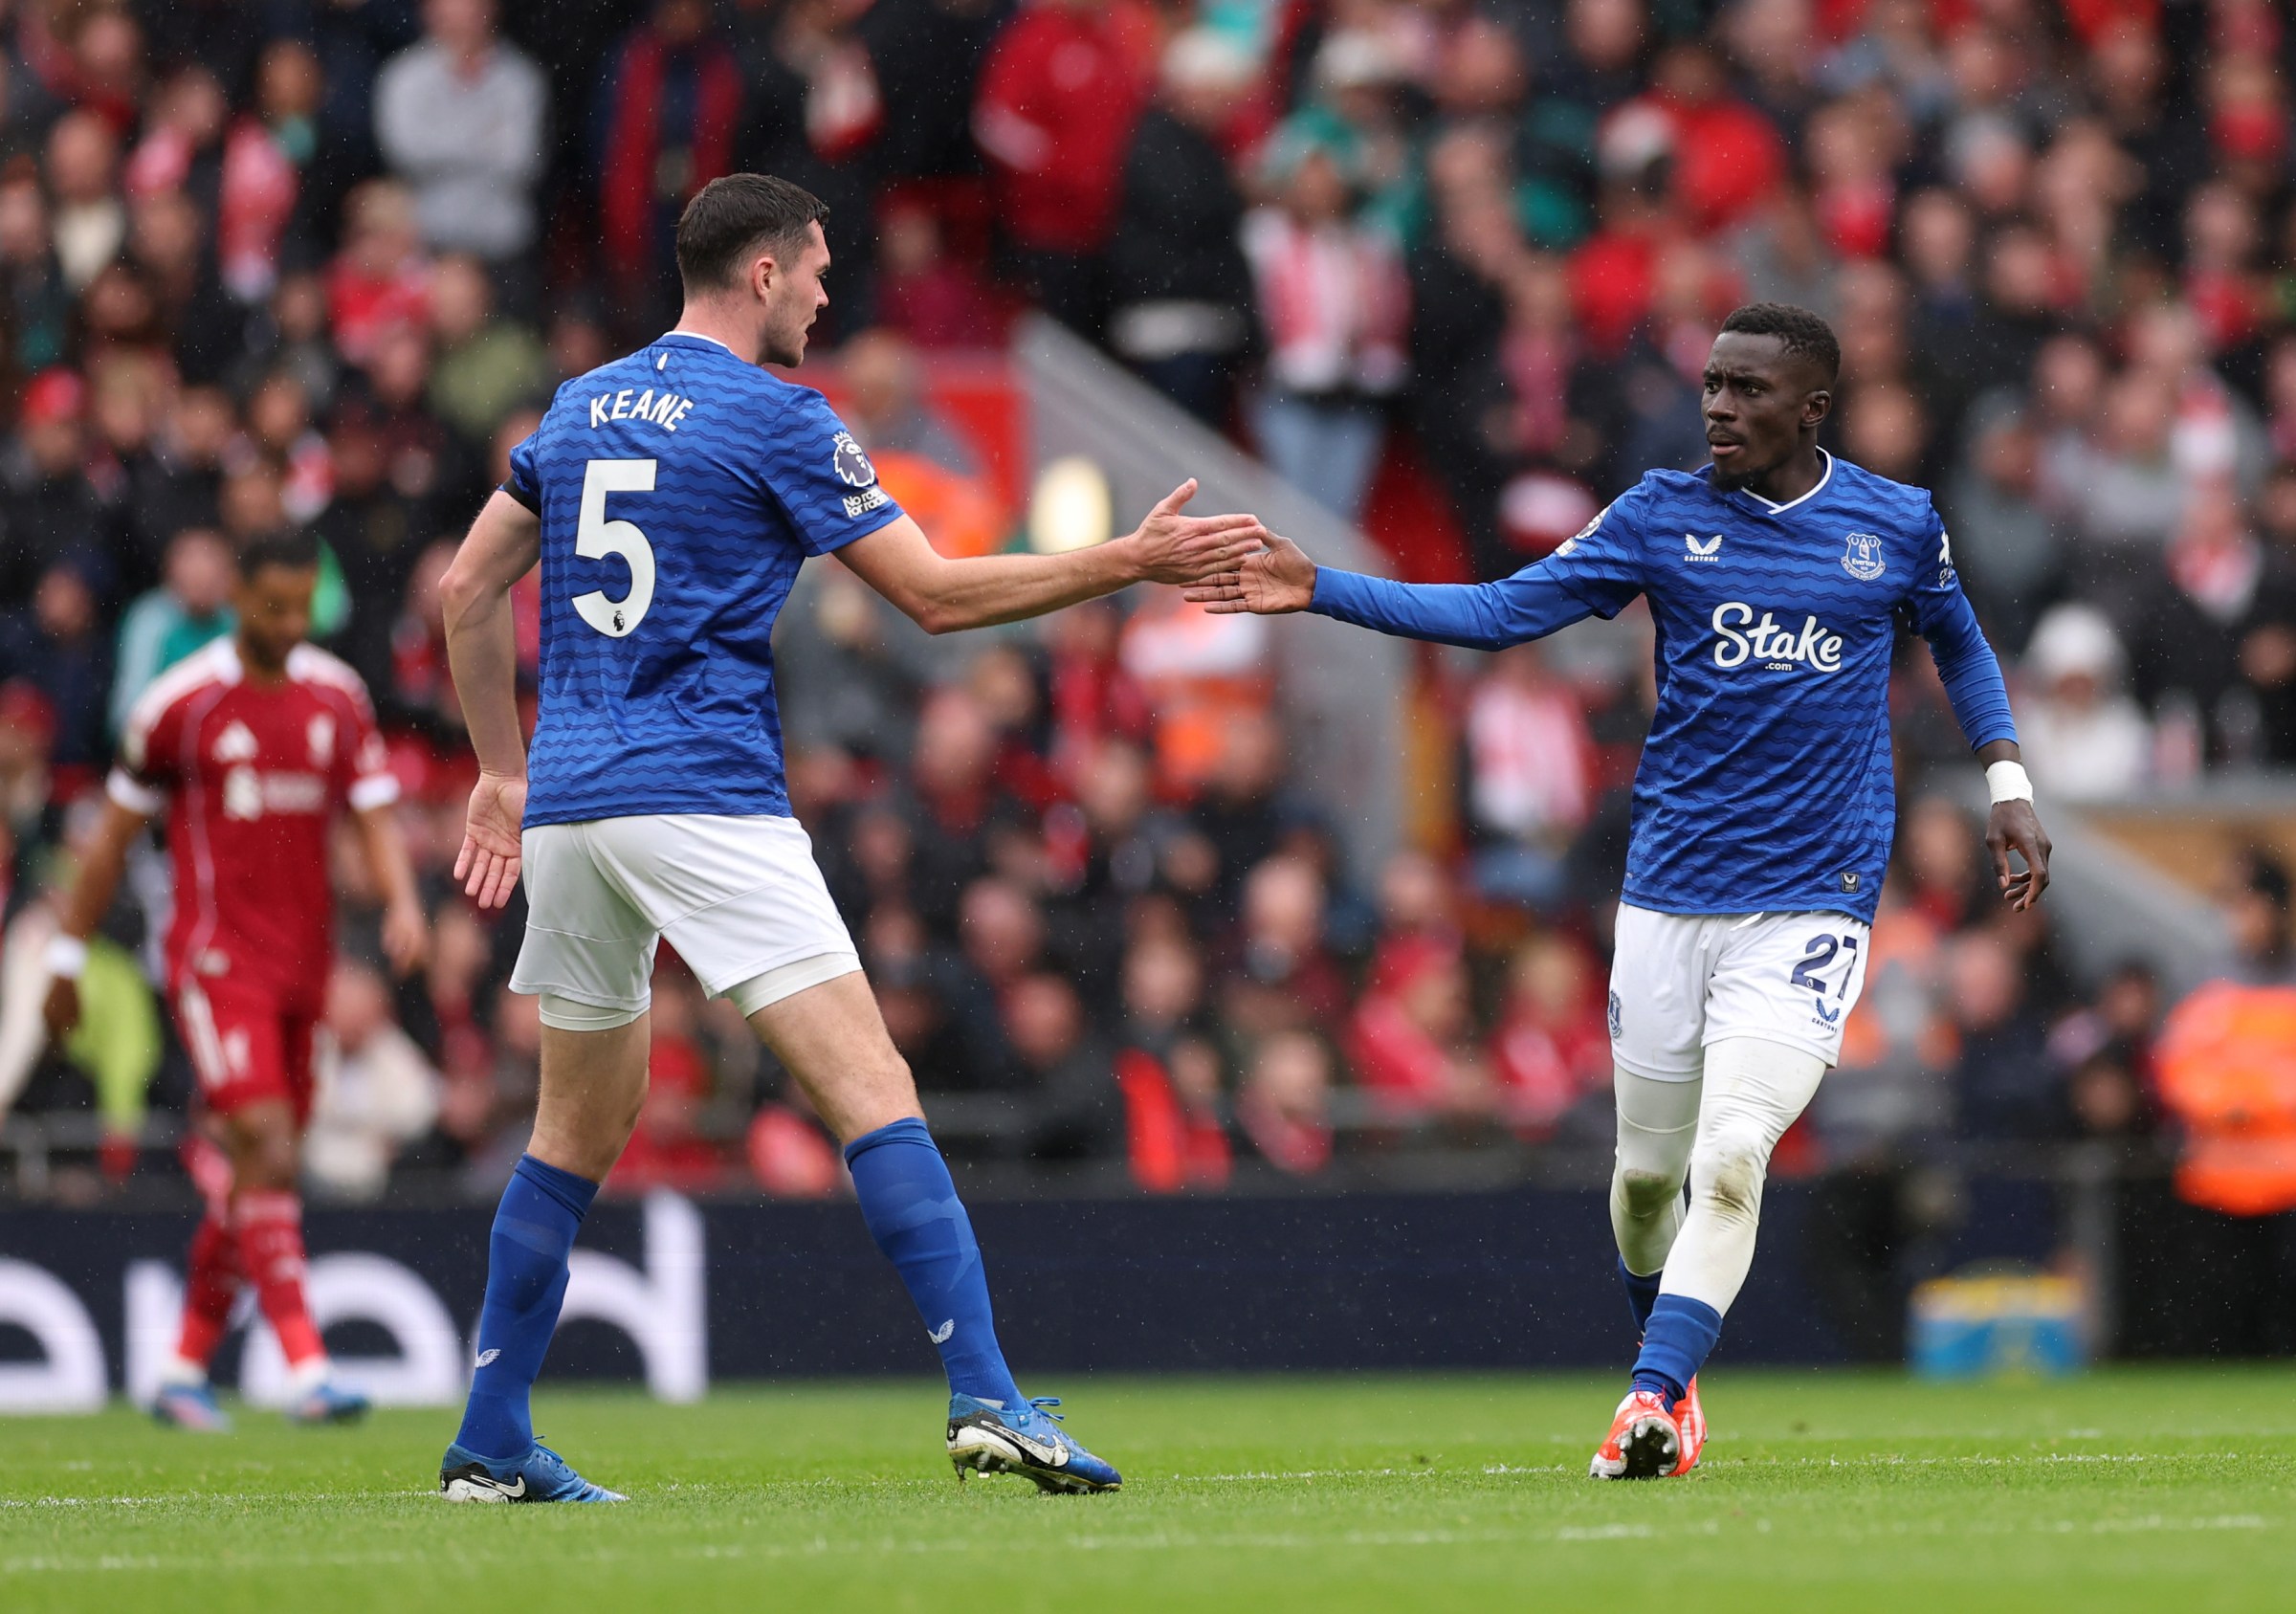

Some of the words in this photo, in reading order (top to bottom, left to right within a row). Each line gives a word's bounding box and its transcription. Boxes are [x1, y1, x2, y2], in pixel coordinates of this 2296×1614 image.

[589, 388, 694, 431] KEANE
[842, 496, 861, 508] No
[846, 504, 863, 518] for
[571, 458, 657, 638] 5
[1851, 558, 1877, 567] Everton
[1711, 602, 1843, 672] Stake
[1764, 661, 1792, 672] .com
[1791, 933, 1857, 1001] 27
